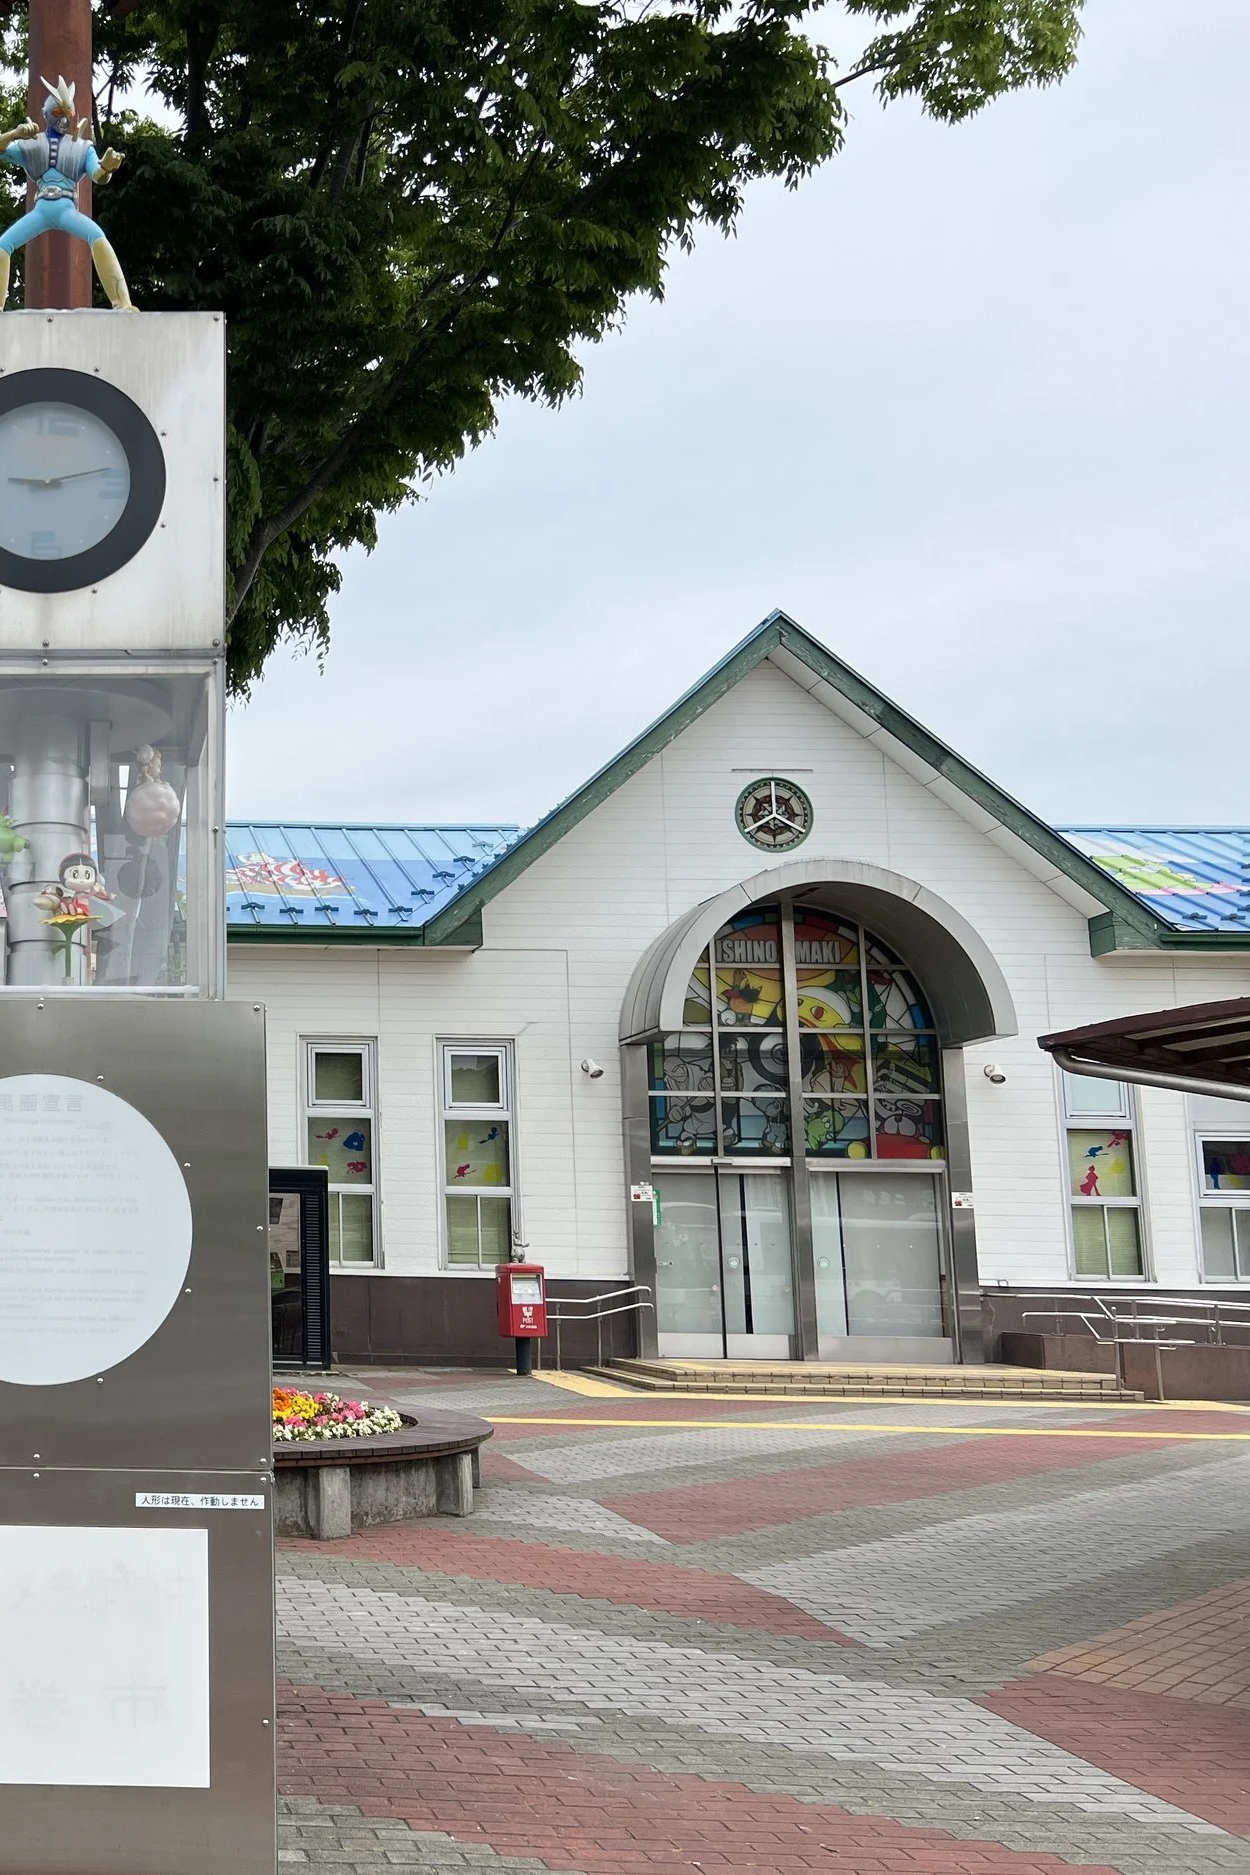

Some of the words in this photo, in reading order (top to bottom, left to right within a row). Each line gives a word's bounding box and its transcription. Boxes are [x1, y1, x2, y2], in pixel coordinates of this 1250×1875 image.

[141, 1494, 259, 1507] 人形は現在、作動しません
